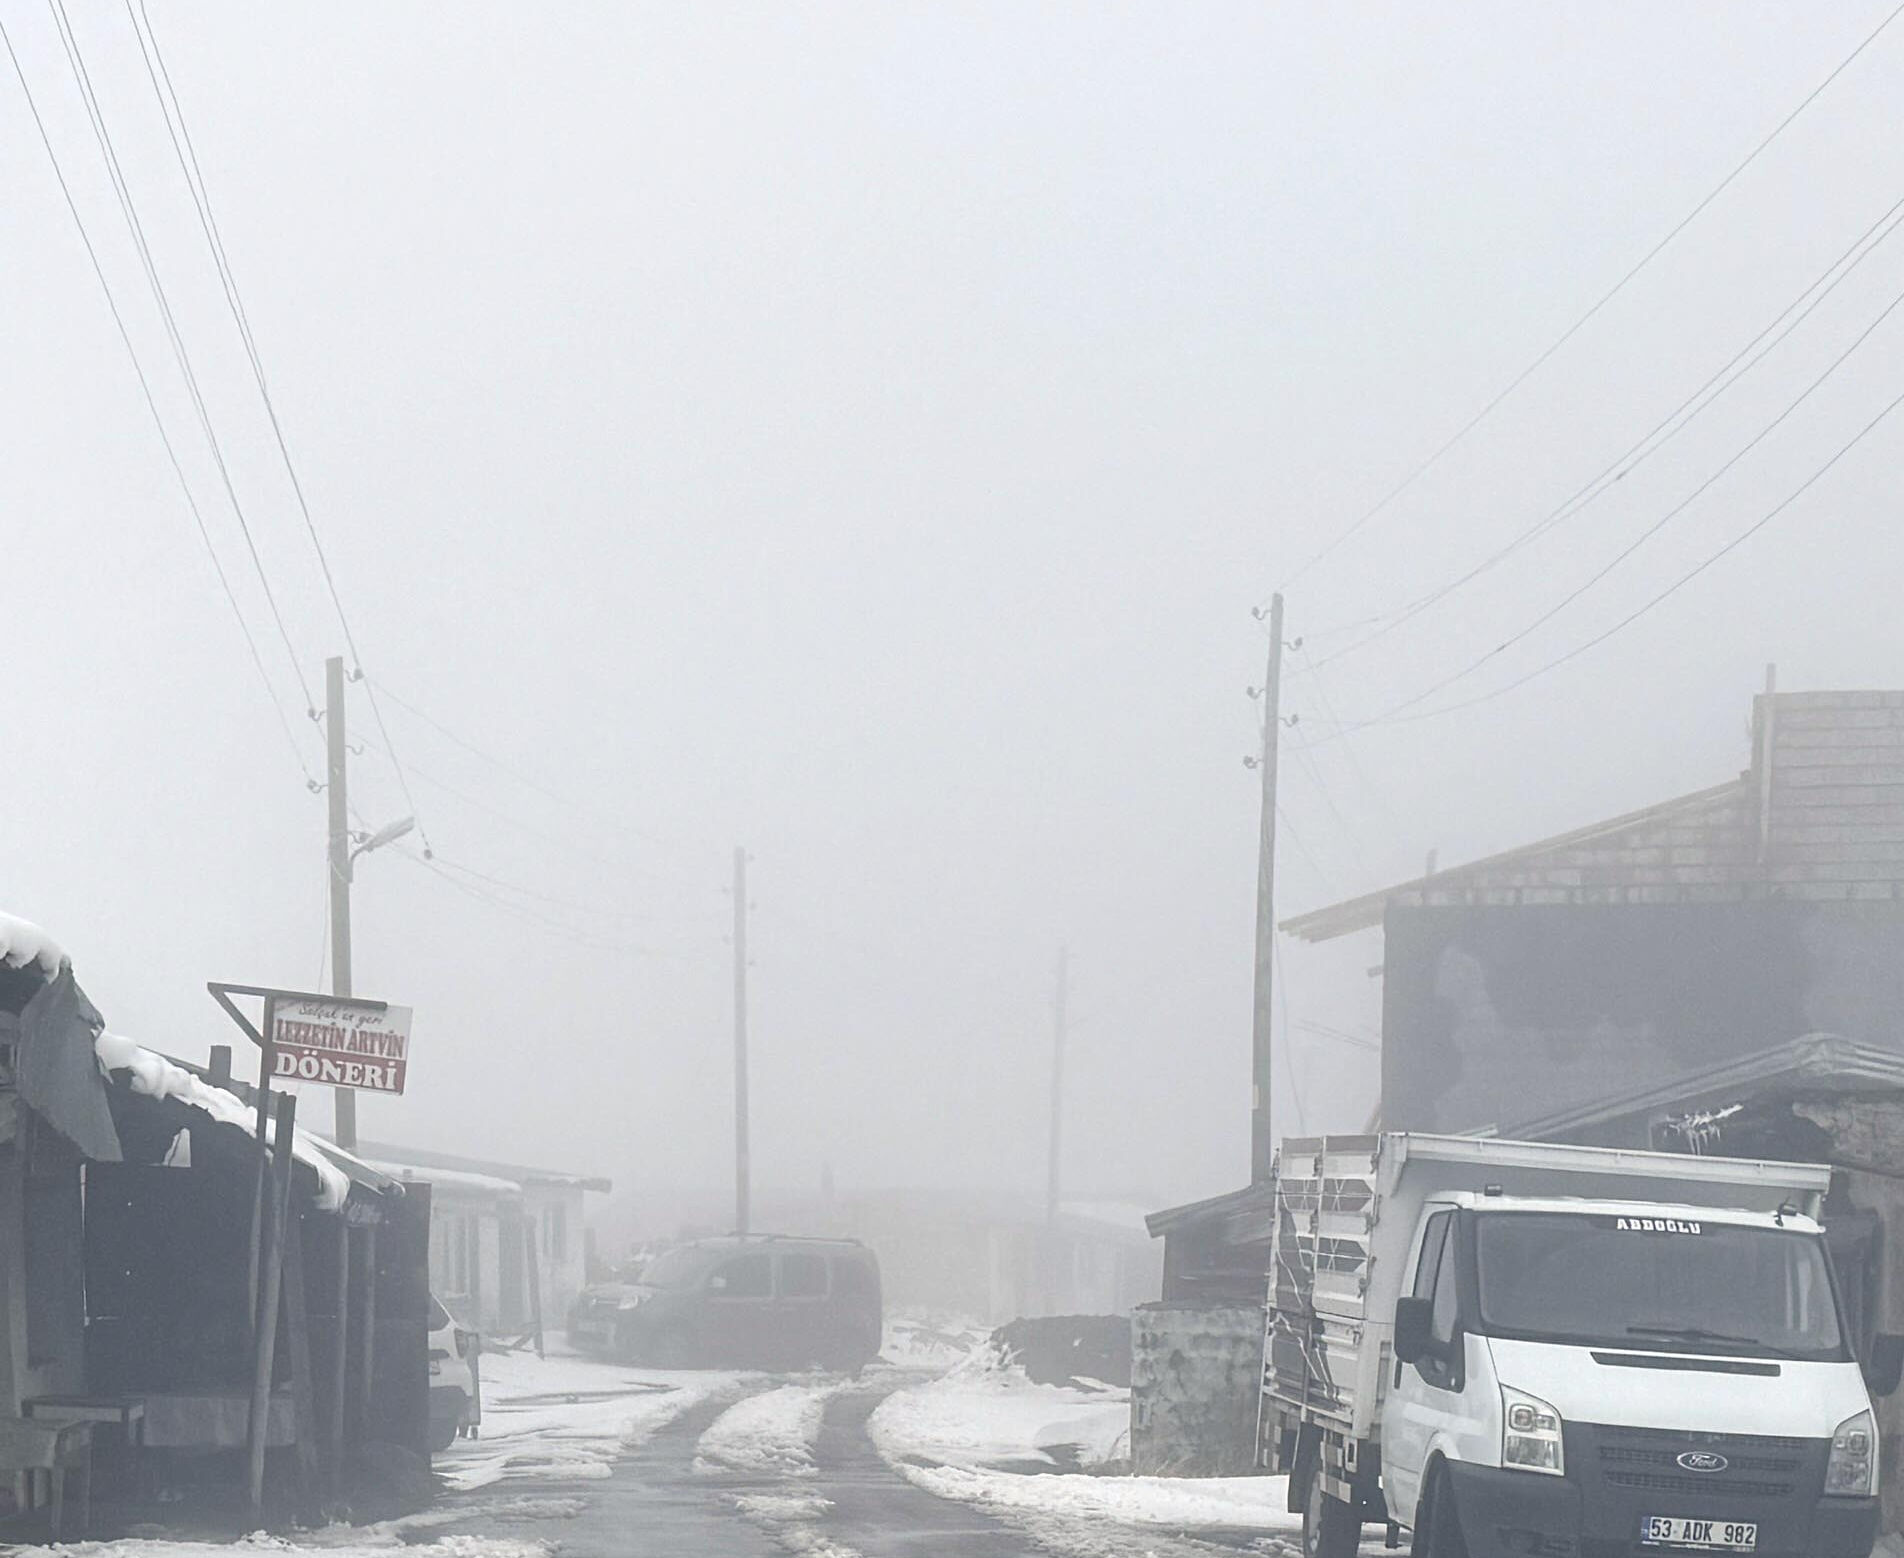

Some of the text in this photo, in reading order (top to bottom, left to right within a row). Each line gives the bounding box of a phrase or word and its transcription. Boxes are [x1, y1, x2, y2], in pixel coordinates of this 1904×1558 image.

[346, 1030, 405, 1058] ARTVİN
[274, 1049, 398, 1089] DÖNERİ
[1651, 1519, 1755, 1544] 53 ADK 982
